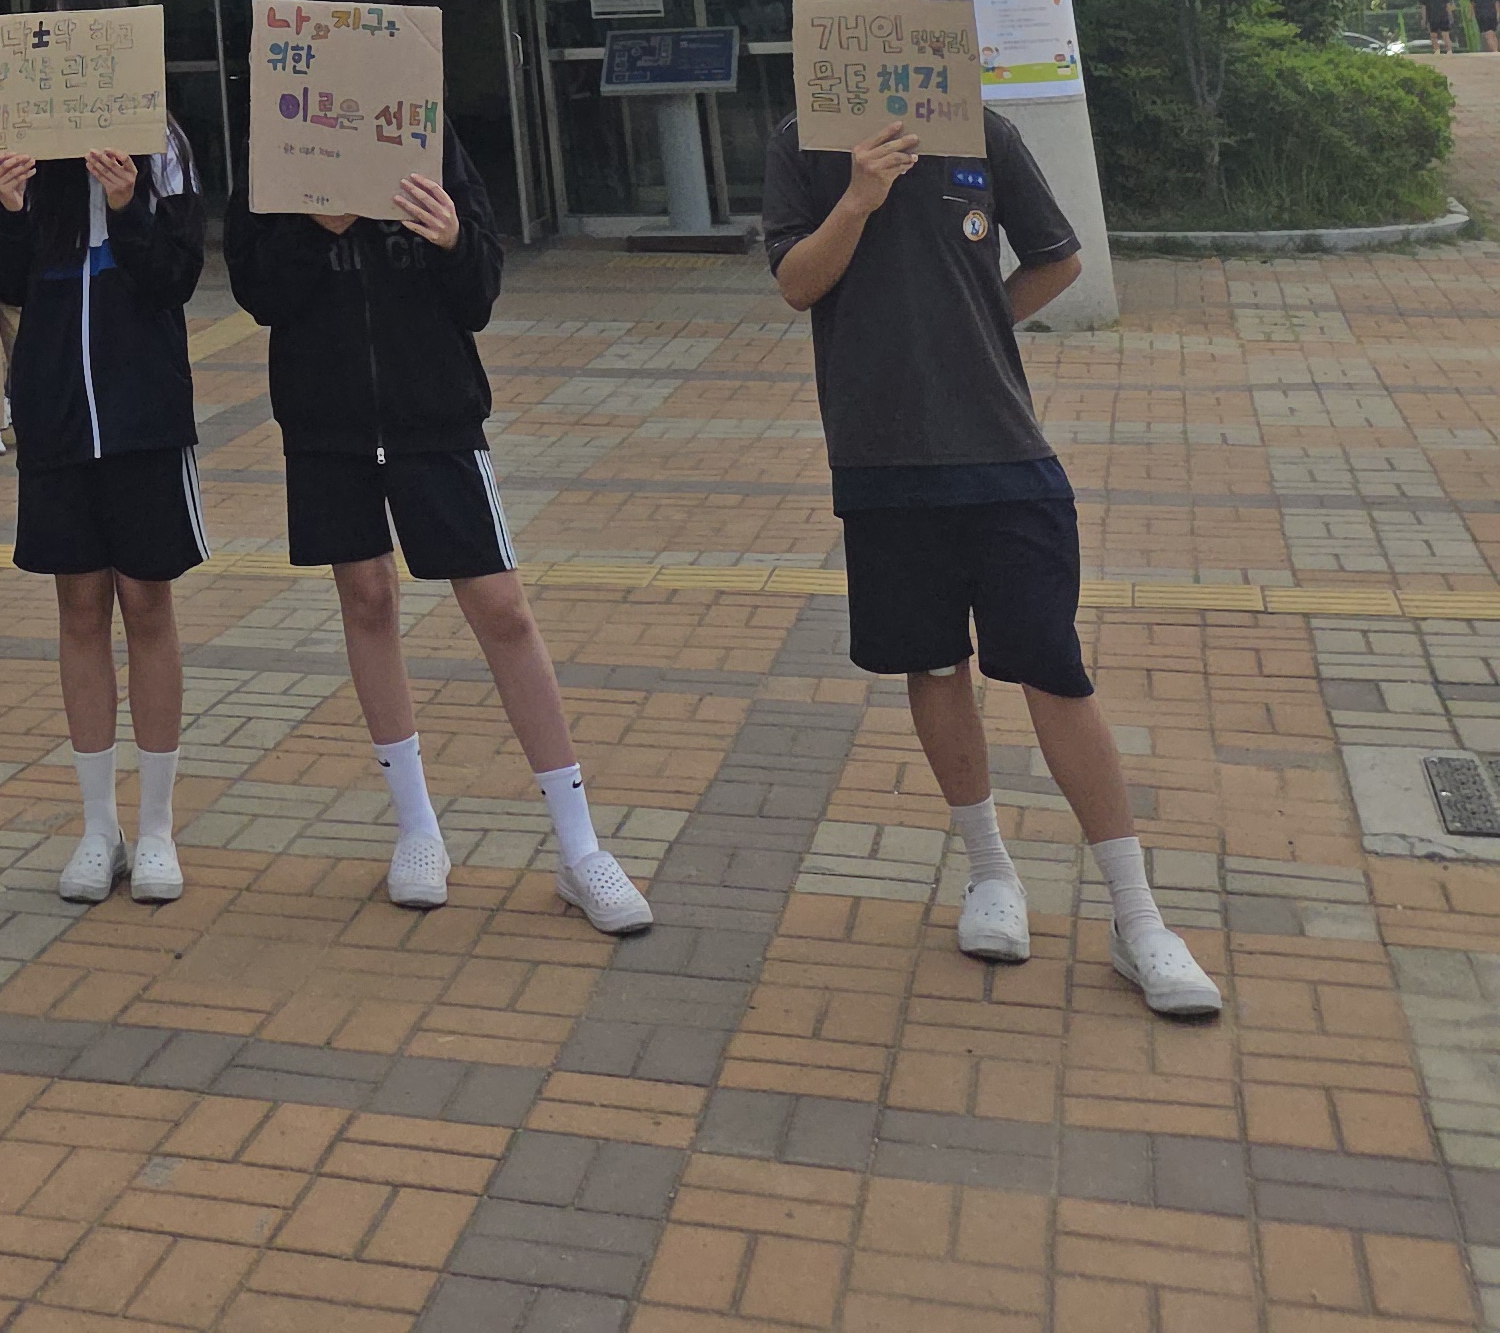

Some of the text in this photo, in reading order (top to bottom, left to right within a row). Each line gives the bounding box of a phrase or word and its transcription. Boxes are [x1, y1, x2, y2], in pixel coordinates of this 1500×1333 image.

[89, 19, 133, 55] 학교
[268, 6, 330, 40] 나와
[811, 15, 902, 53] 개인
[267, 41, 316, 75] 위한
[808, 61, 948, 116] 물통 챙겨
[279, 87, 438, 149] 이로운 선택
[915, 98, 969, 123] 다니기
